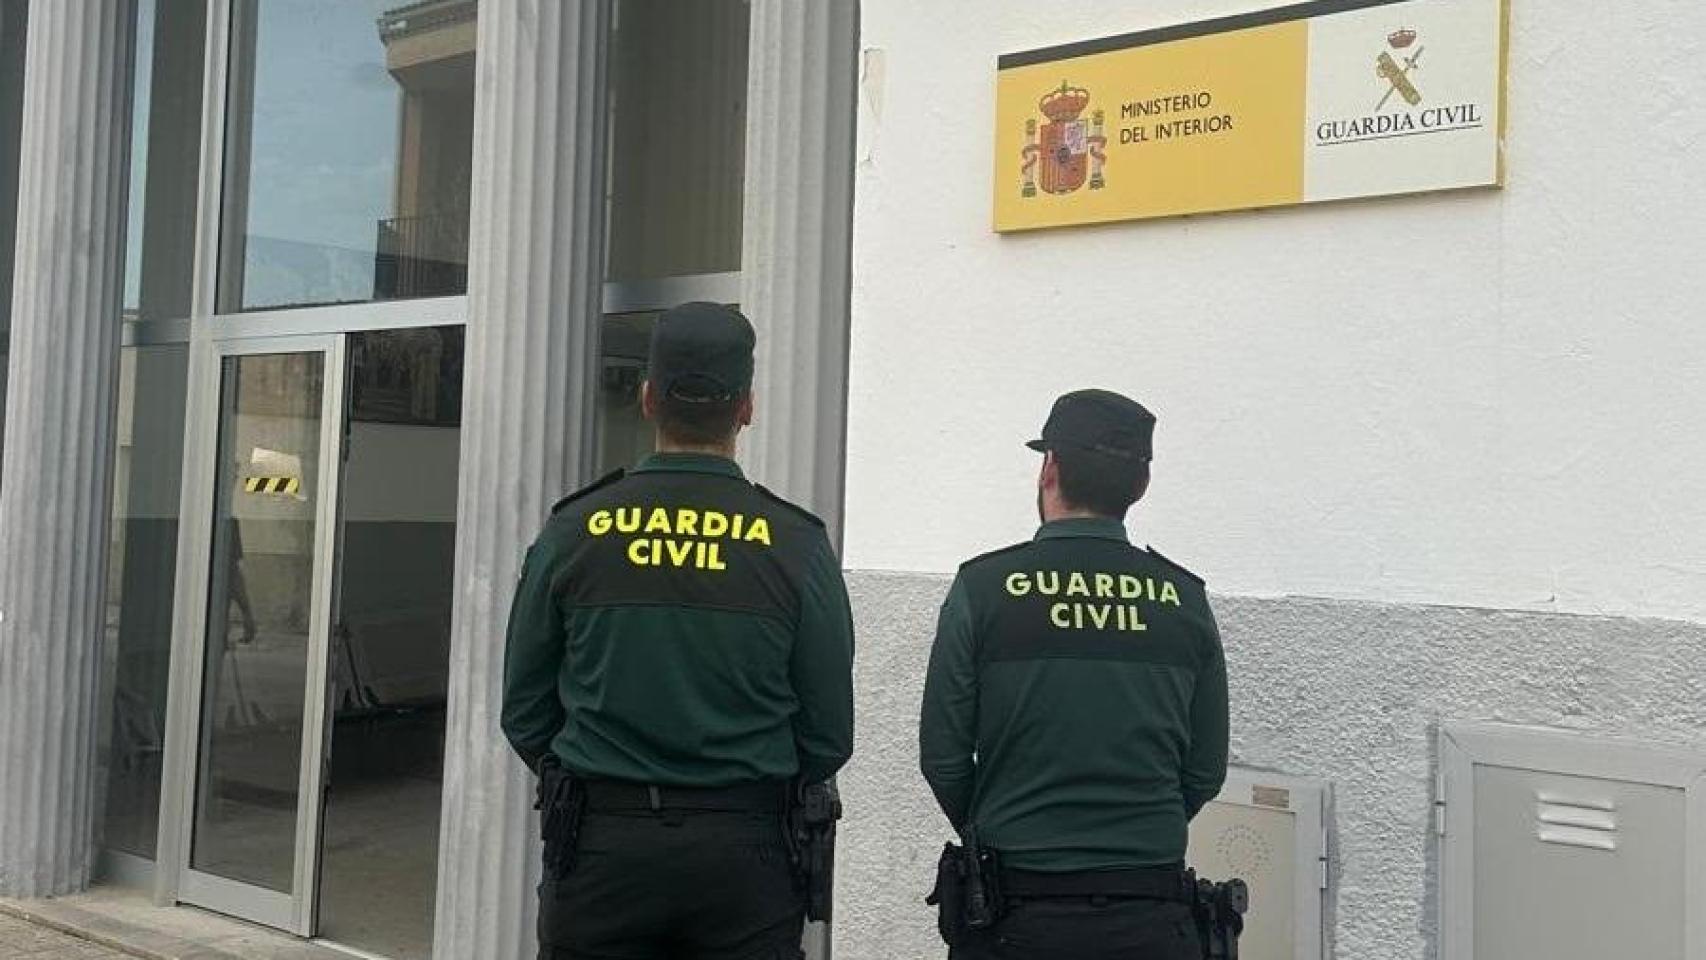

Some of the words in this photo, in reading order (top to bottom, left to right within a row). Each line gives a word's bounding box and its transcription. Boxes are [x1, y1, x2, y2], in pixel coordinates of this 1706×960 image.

[1121, 91, 1212, 119] MINISTERIO
[1120, 123, 1149, 144] DEL
[1154, 114, 1234, 141] INTERIOR
[1316, 112, 1415, 141] GUARDIA
[1419, 103, 1481, 130] CIVIL
[588, 507, 771, 546] GUARDIA
[628, 538, 727, 570] CIVIL
[1005, 570, 1182, 606] GUARDIA
[1051, 602, 1148, 631] CIVIL
